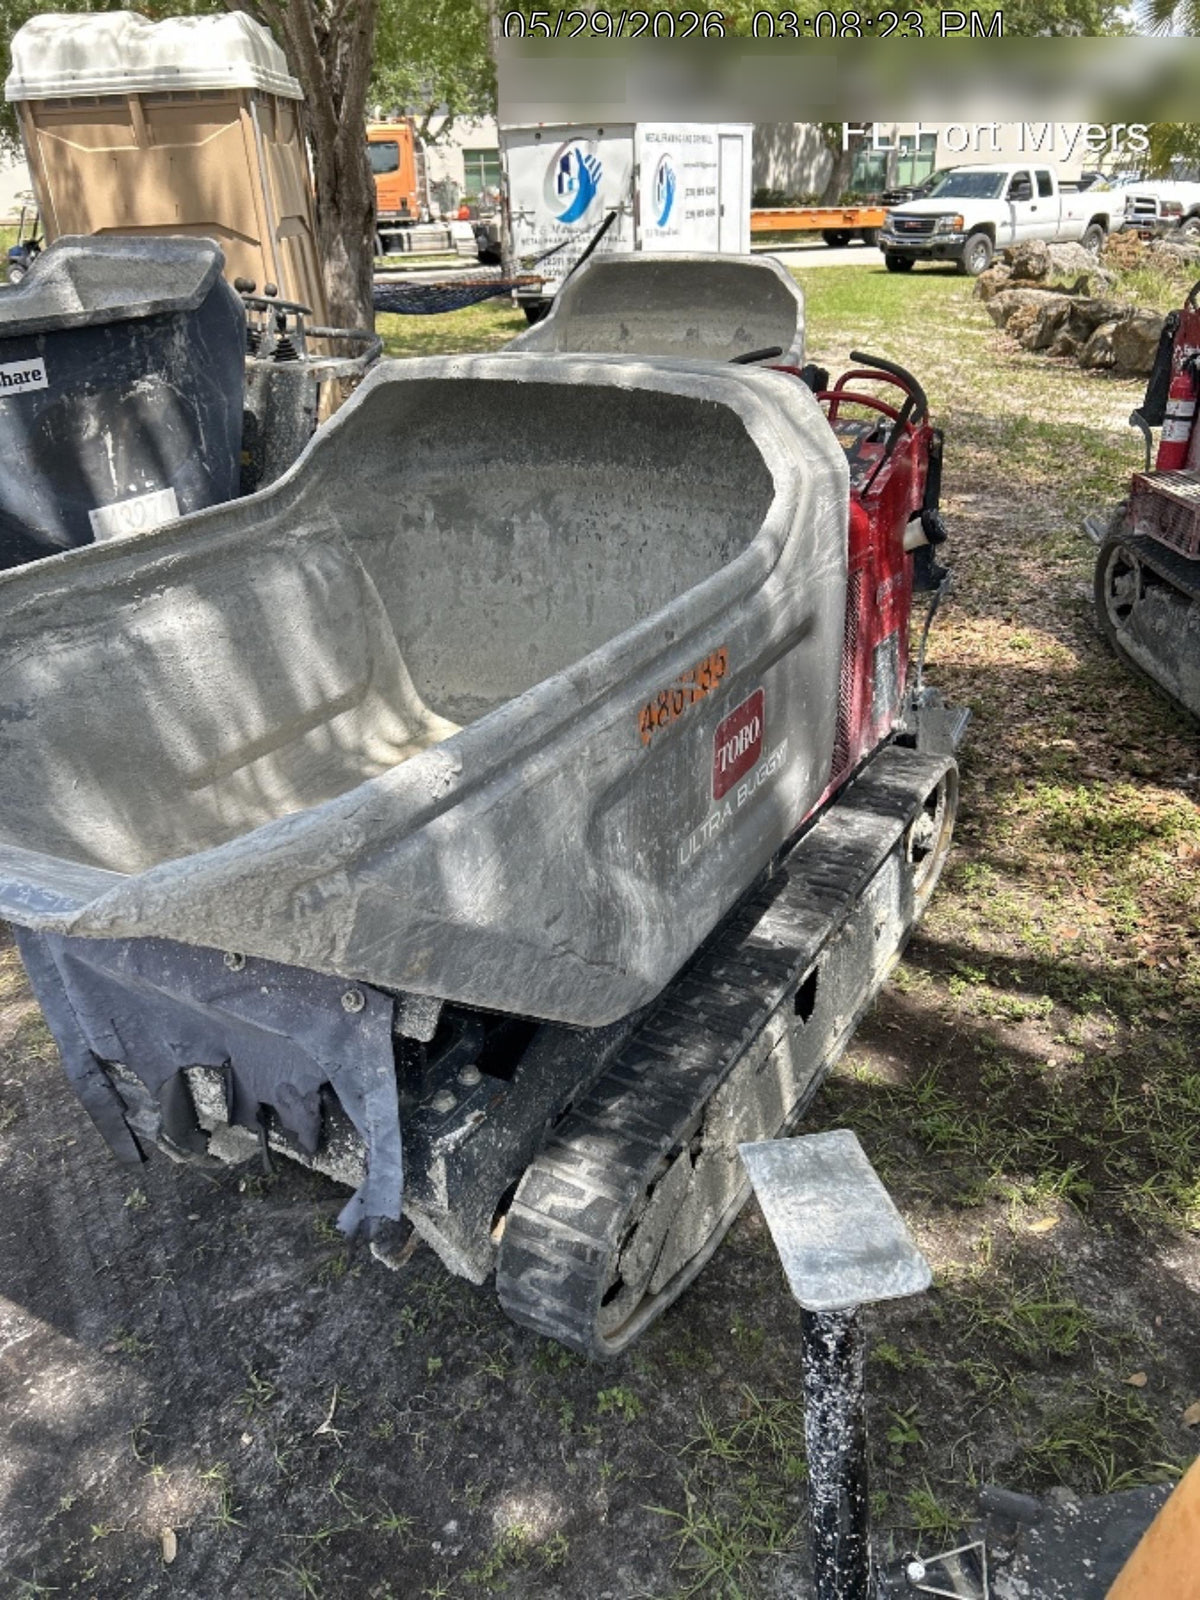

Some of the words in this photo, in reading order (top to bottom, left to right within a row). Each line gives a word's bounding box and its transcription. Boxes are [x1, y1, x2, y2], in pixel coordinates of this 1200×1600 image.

[0, 369, 42, 387] hare
[717, 716, 761, 774] TORO
[678, 801, 733, 865] ULTRA
